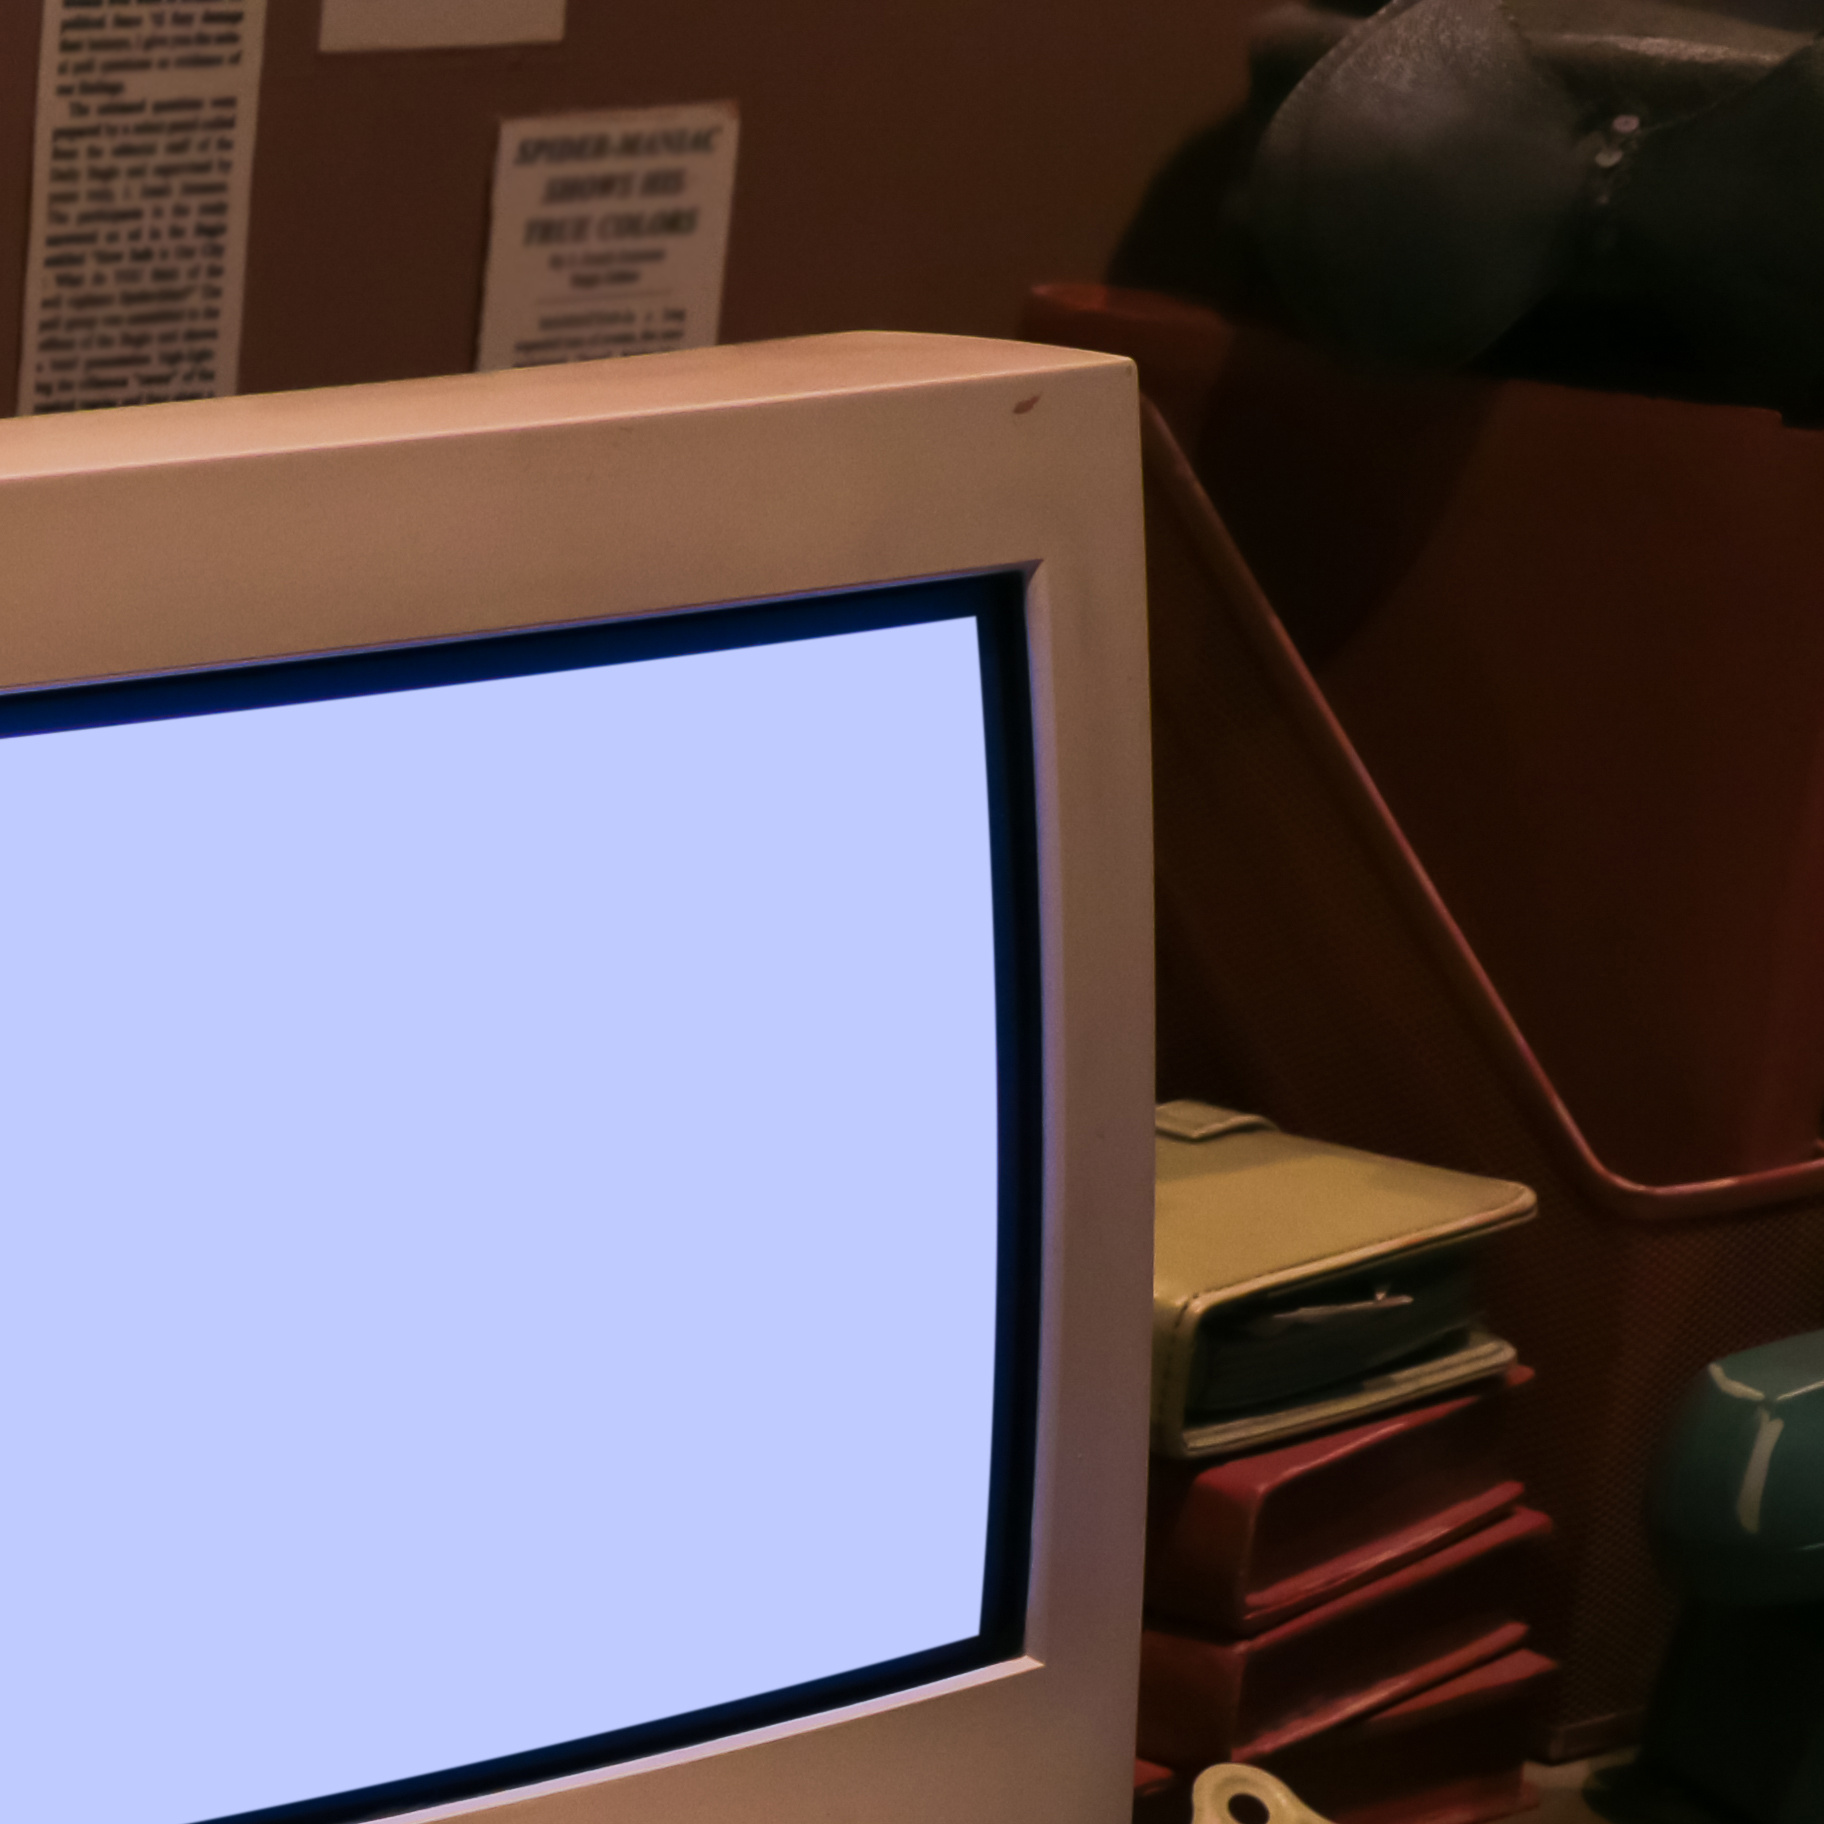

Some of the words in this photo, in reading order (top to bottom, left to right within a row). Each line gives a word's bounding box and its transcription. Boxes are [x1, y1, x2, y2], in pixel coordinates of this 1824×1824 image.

[515, 127, 722, 165] SPIDER-MANIAC
[524, 213, 590, 247] TRUE
[596, 207, 699, 240] COLORS
